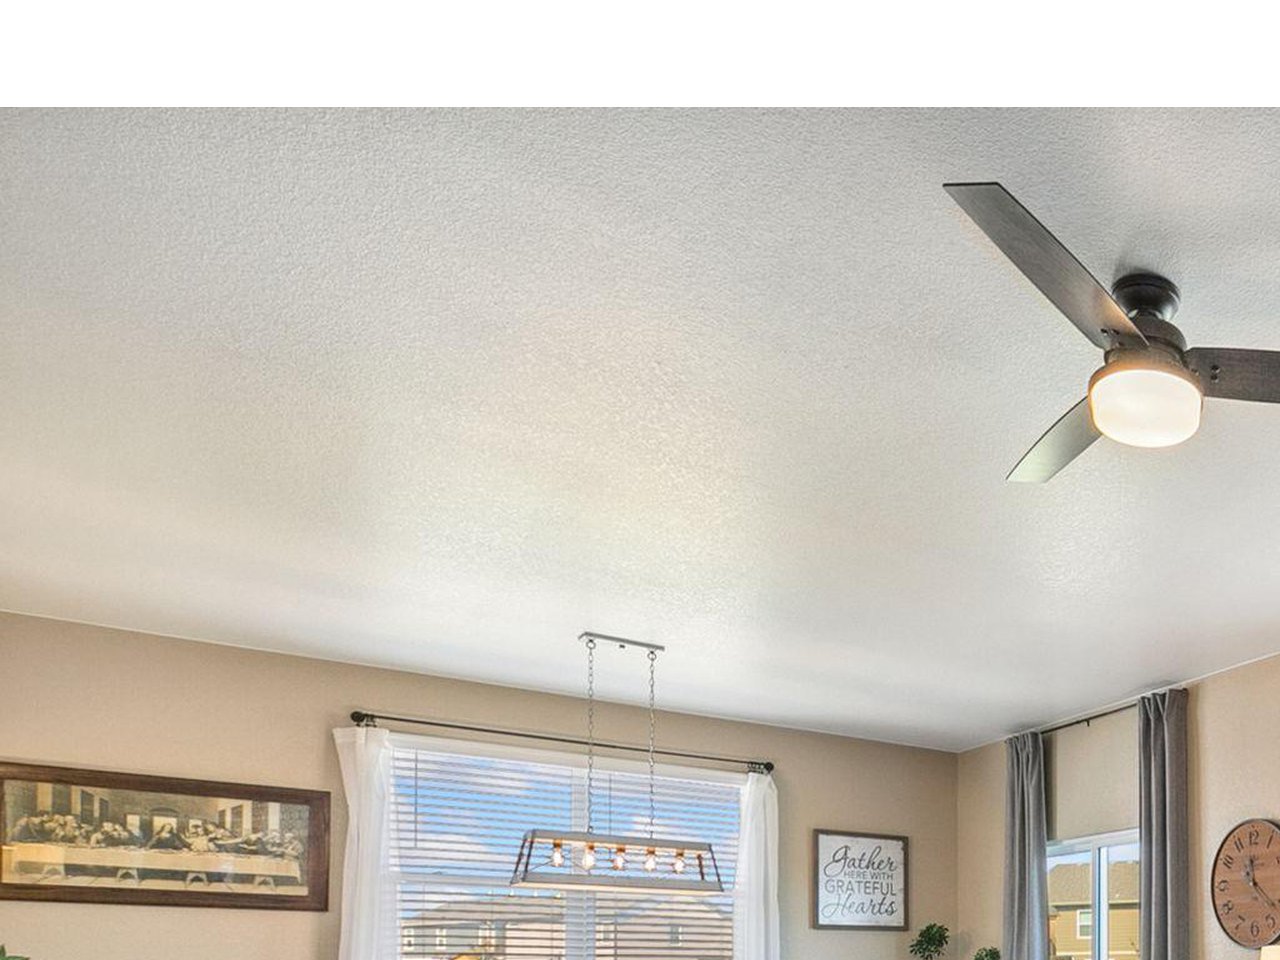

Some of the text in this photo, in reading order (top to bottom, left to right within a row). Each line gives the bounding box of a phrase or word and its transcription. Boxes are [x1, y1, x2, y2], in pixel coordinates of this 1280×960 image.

[1234, 837, 1245, 853] 11
[1249, 829, 1260, 845] 12
[823, 844, 897, 877] Gather
[844, 870, 894, 880] HERE WITH
[824, 879, 897, 896] GRATEFUL
[821, 892, 898, 918] Hearts
[1222, 899, 1235, 915] 8
[1250, 920, 1260, 937] 6
